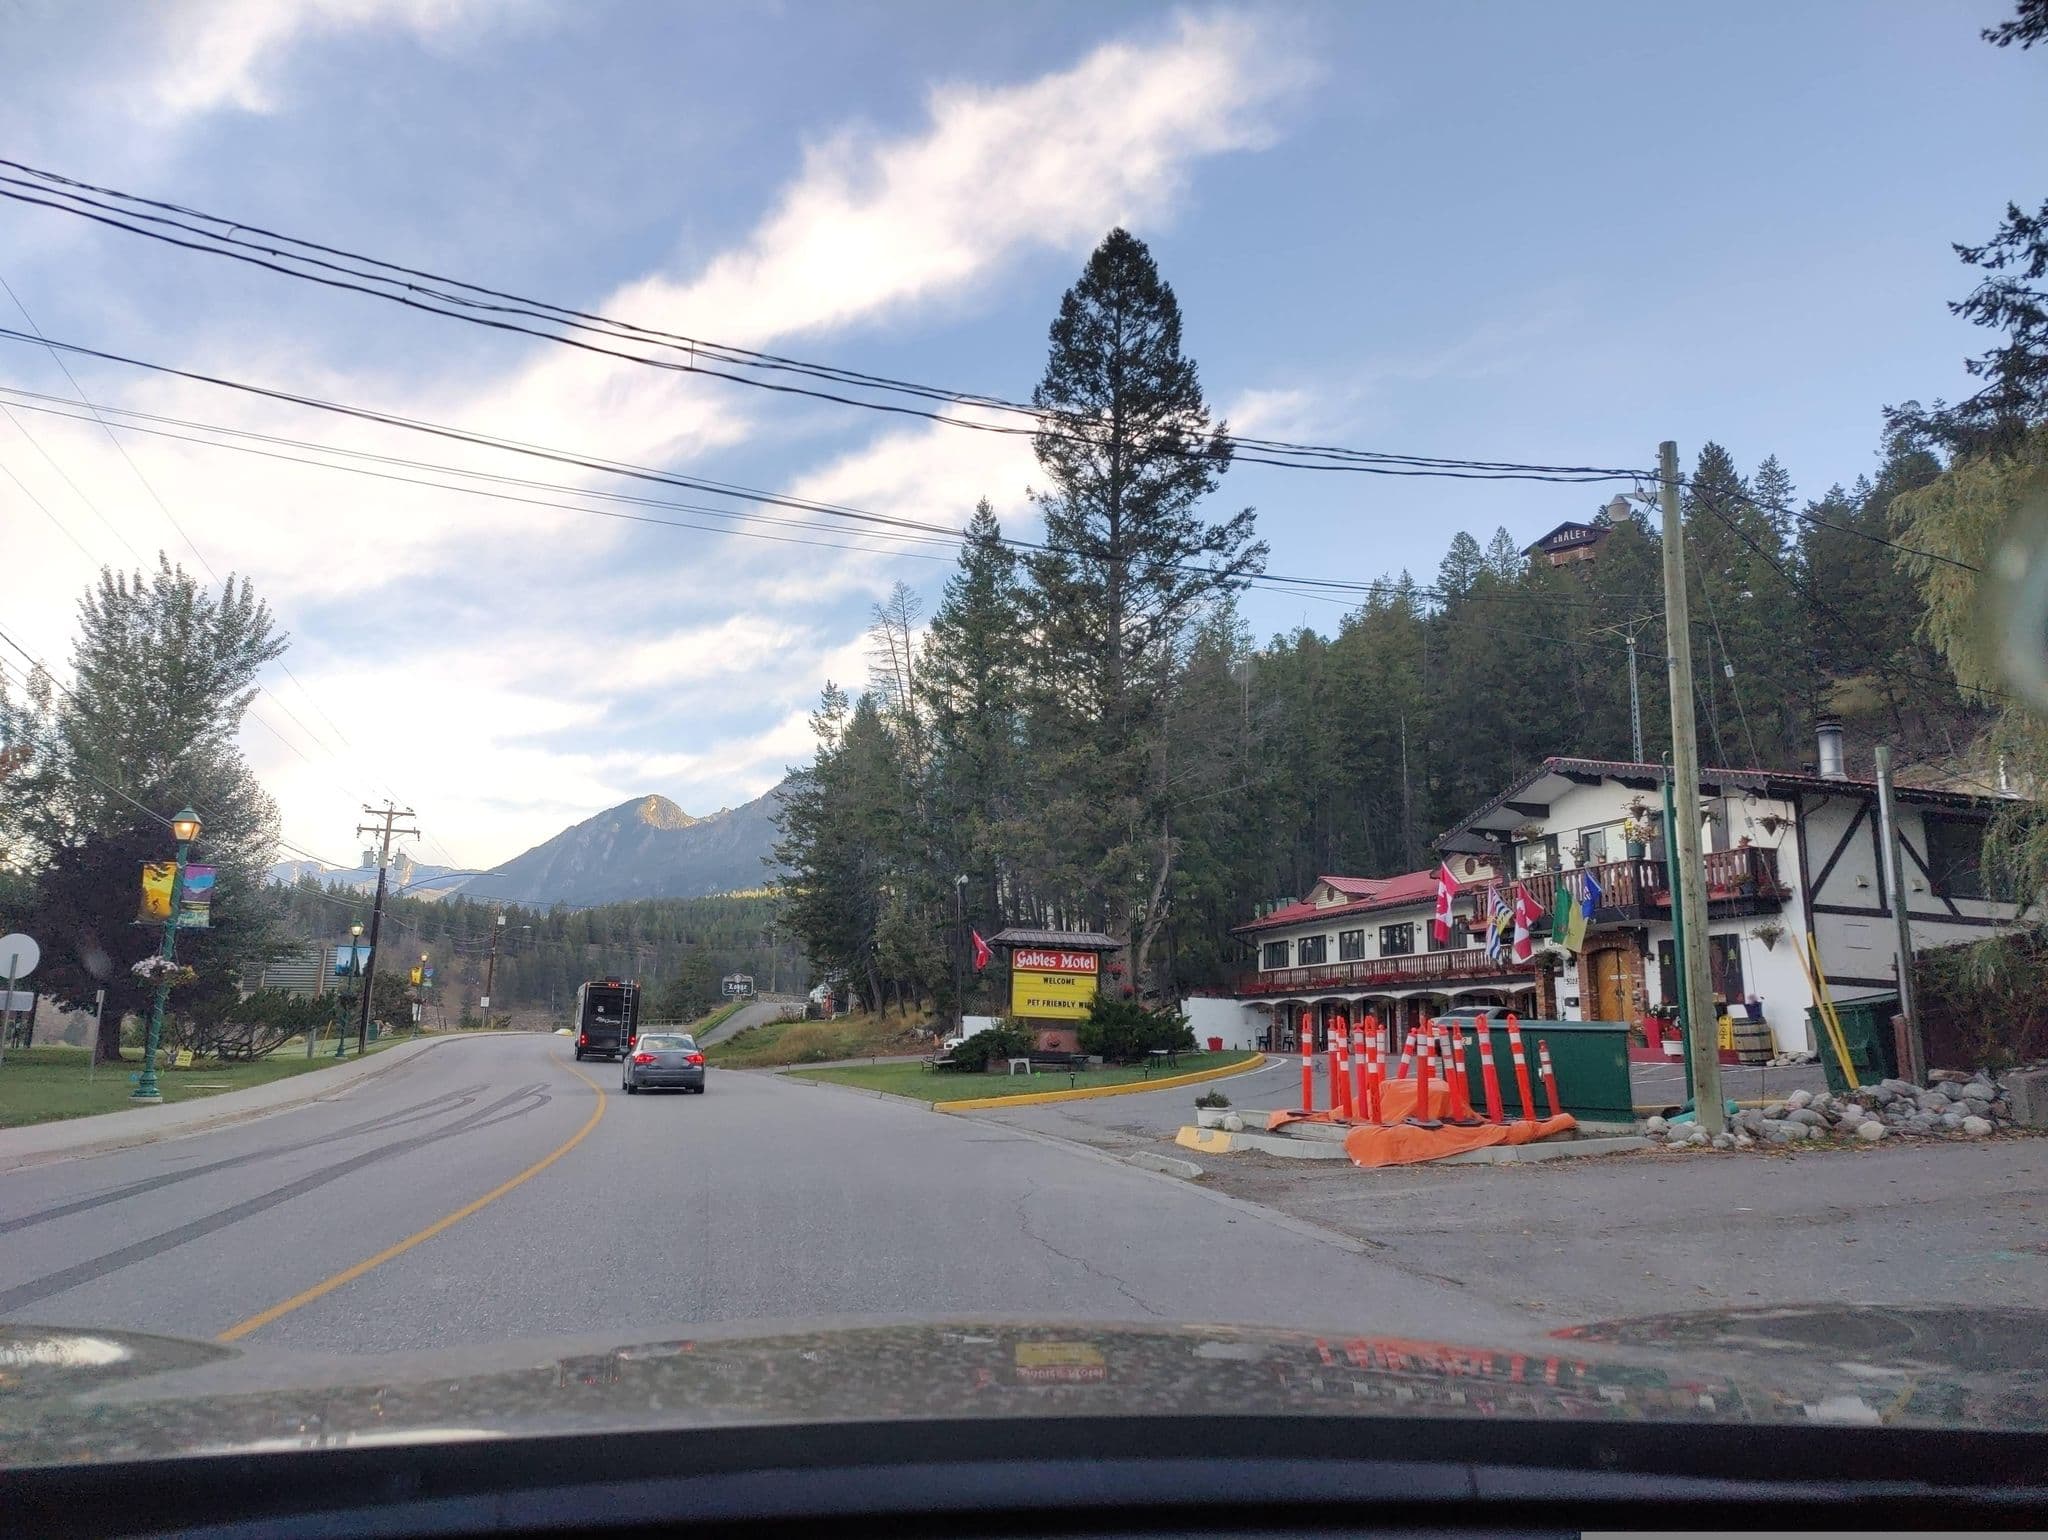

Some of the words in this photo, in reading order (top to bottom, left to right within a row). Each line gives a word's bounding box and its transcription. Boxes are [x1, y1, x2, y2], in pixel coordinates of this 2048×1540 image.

[1016, 951, 1056, 968] Gables
[1061, 954, 1095, 970] Motel
[1043, 977, 1075, 986] WELCOME
[1027, 999, 1040, 1007] PET
[1043, 999, 1075, 1008] FRIENDLY
